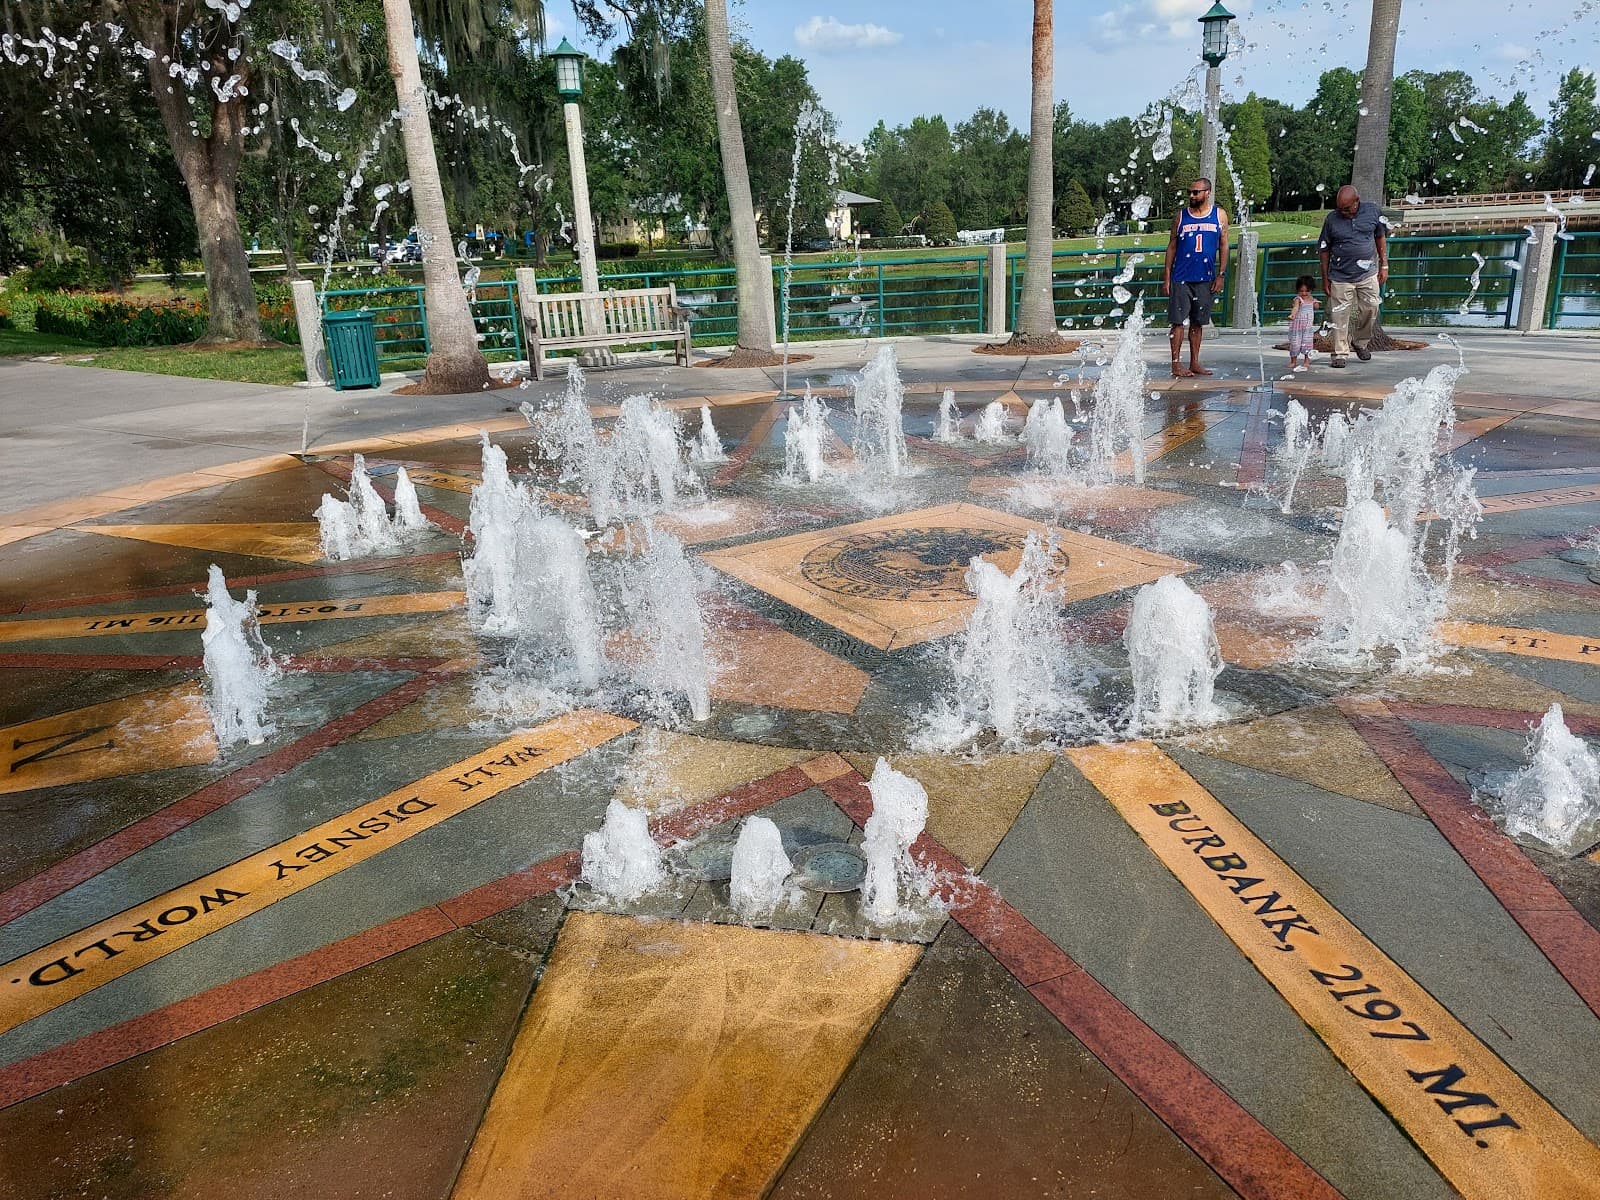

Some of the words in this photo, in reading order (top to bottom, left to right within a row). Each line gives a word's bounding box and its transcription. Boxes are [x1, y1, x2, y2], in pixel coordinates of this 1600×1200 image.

[1195, 233, 1203, 252] 1
[146, 614, 203, 627] 1116
[257, 603, 363, 618] BOSTO
[447, 746, 552, 792] WALT
[268, 796, 438, 880] DISNEY
[10, 888, 251, 987] WORLD.
[1148, 800, 1320, 951] BURBANK,
[1308, 964, 1431, 1041] 2197
[1406, 1063, 1522, 1148] MI.
